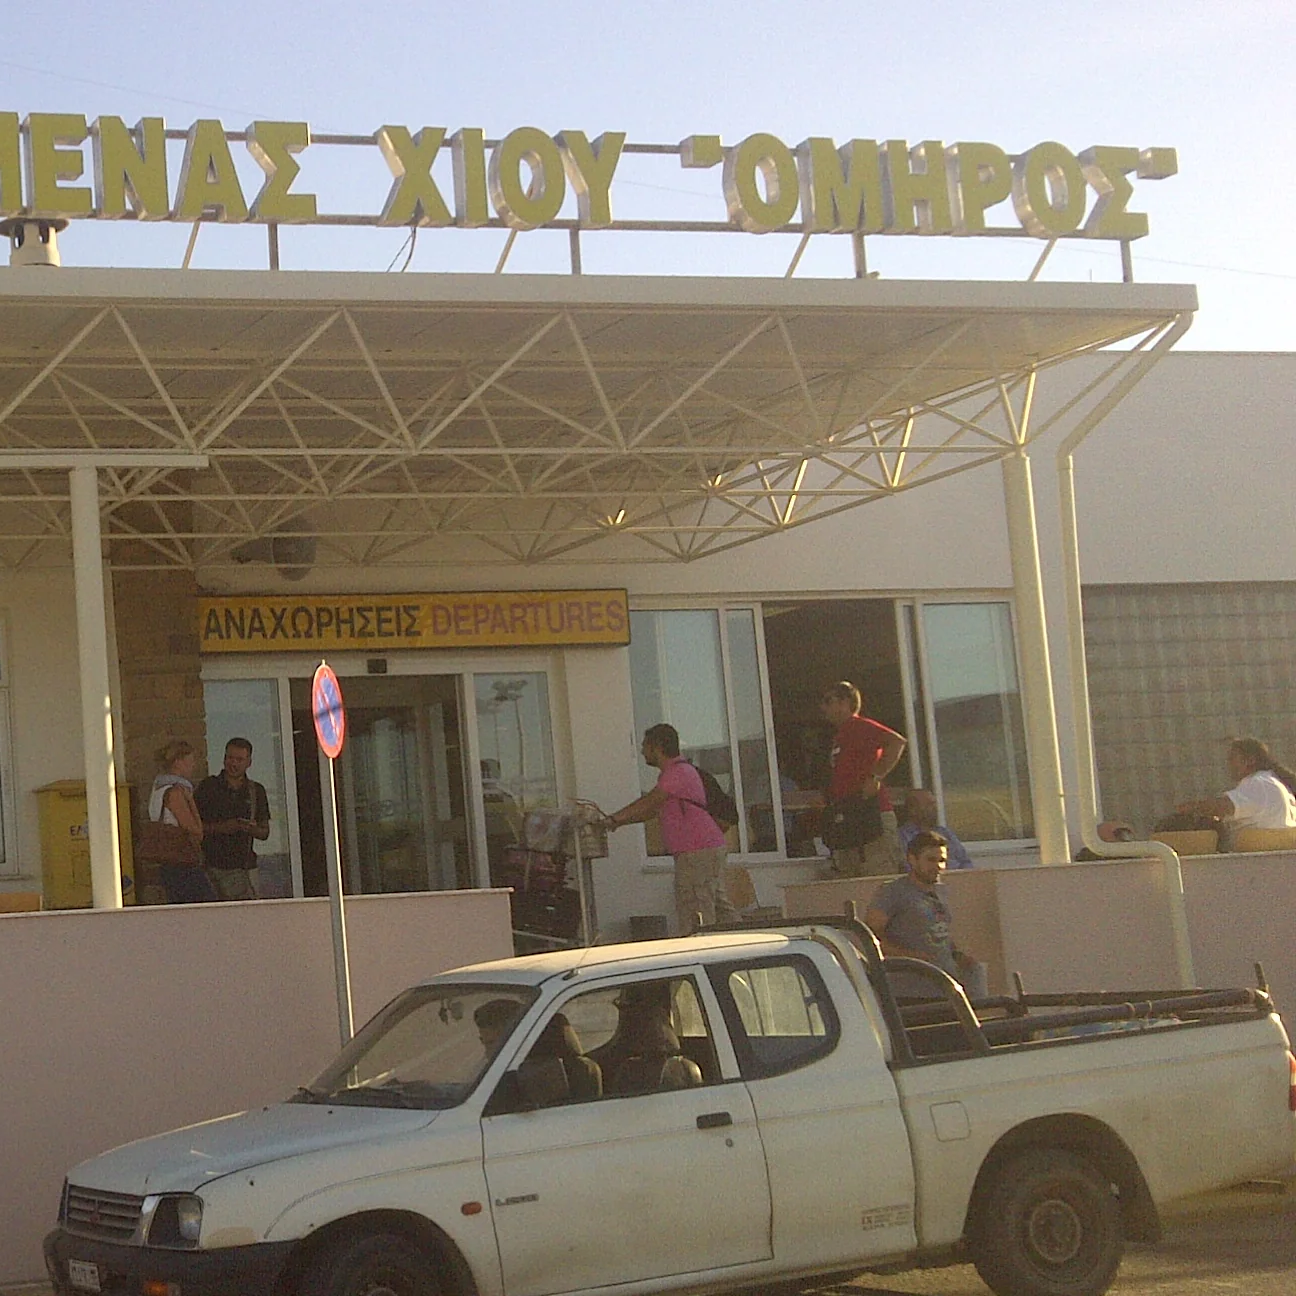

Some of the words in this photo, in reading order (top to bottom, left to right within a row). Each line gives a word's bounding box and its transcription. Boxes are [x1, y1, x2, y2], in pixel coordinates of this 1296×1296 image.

[373, 125, 627, 231] ΧΙΟΥ
[205, 604, 422, 640] ΑΝΑΧΩΡΗΣΕΙΣ
[431, 600, 626, 636] DEPARTURES
